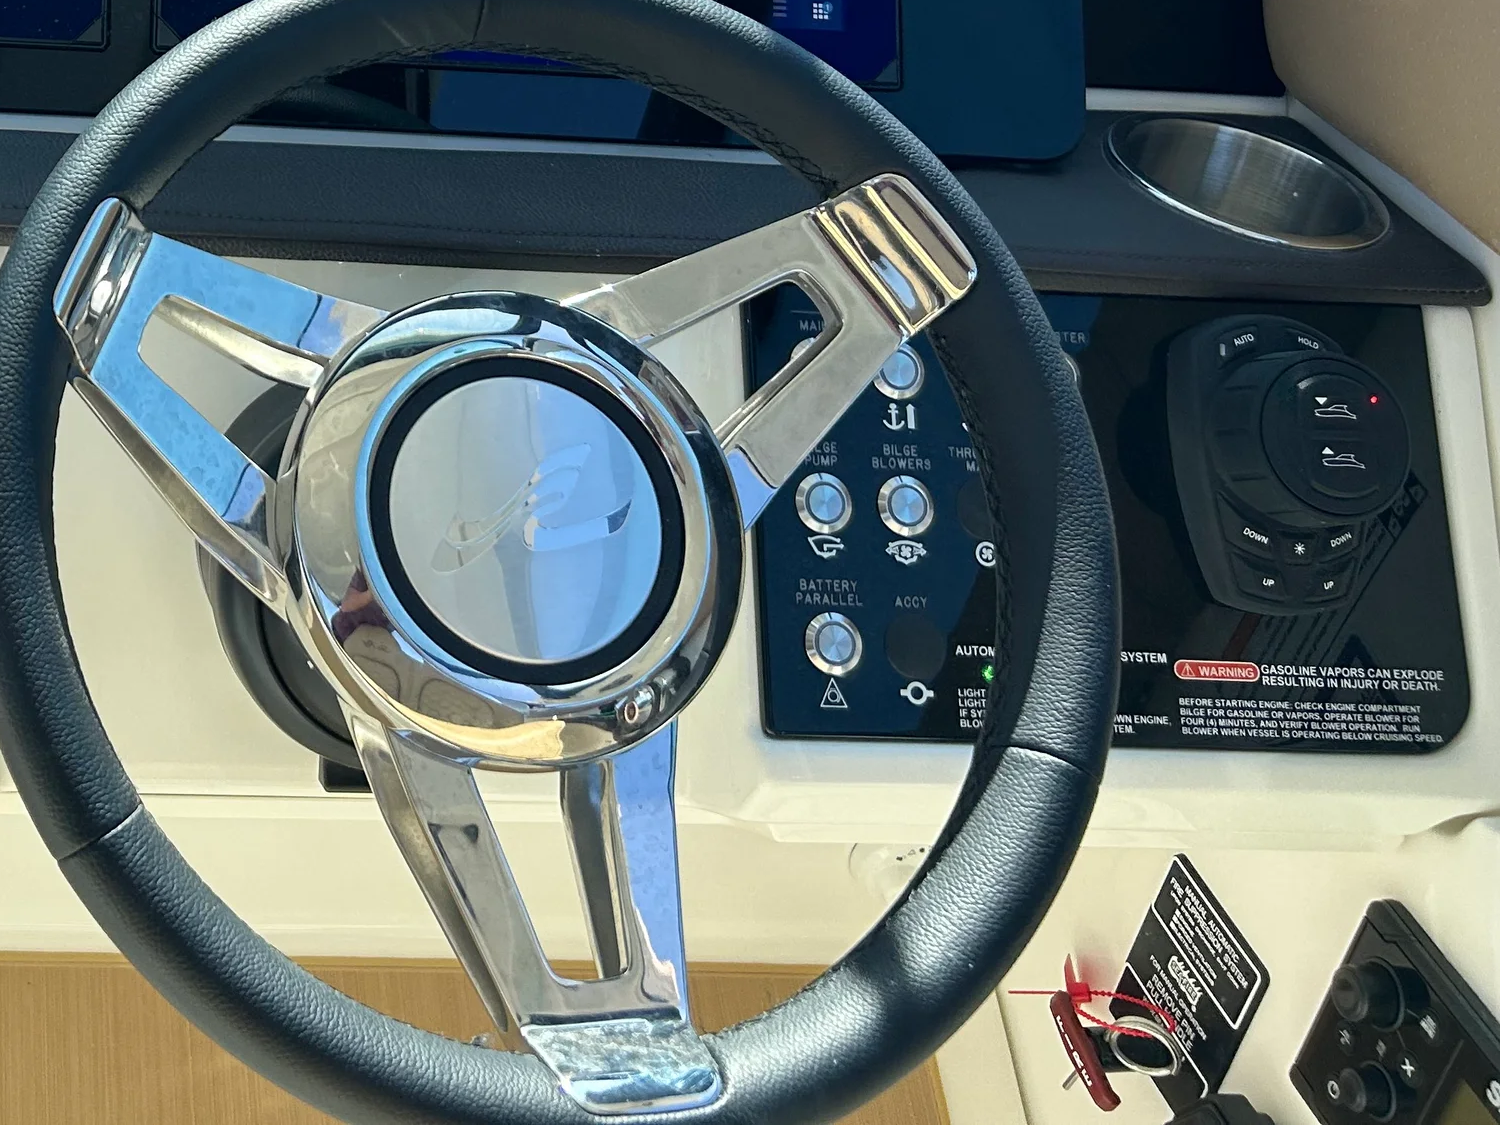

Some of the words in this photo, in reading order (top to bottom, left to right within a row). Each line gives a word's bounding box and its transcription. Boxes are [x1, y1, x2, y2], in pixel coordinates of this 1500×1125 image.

[1233, 333, 1255, 347] AUTO
[1297, 336, 1320, 350] HOLD
[883, 444, 918, 457] BILGE
[804, 454, 838, 467] PUMP
[872, 457, 931, 470] BLOWERS
[1242, 526, 1269, 545] DOWN
[1330, 531, 1352, 548] DOWN
[800, 579, 857, 593] BATTERY
[1262, 578, 1275, 588] UP
[1323, 580, 1334, 590] UP
[796, 592, 863, 607] PARALLEL
[895, 596, 927, 609] ACCY
[1120, 651, 1167, 664] SYSTEM
[1198, 665, 1255, 678] WARNING
[1260, 664, 1316, 676] GASOLINE
[1319, 666, 1365, 678] VAPORS
[1367, 668, 1391, 679] CAN
[1393, 669, 1444, 681] EXPLODE
[1262, 676, 1324, 688] RESULTING
[1327, 678, 1338, 688] IN
[1340, 679, 1380, 689] INJURY
[1382, 680, 1399, 690] OR
[1401, 681, 1441, 691] DEATH.
[958, 688, 986, 697] LIGHT
[958, 698, 986, 708] LIGHT
[1179, 697, 1213, 707] BEFORE
[1215, 699, 1257, 708] STARTING
[1294, 702, 1324, 711] CHECK
[1326, 703, 1356, 711] ENGINE
[1358, 703, 1421, 713] COMPARTMENT
[1180, 708, 1205, 716] BILGE
[1207, 709, 1225, 717] FOR
[1226, 710, 1269, 719] GASOLINE
[1324, 713, 1364, 722] OPERATE
[1365, 714, 1400, 723] BLOWER
[1402, 715, 1420, 723] FOR
[1181, 717, 1205, 726] FOUR
[1260, 720, 1278, 728] AND
[1279, 721, 1309, 730] VERIFY
[1311, 722, 1347, 730] BLOWER
[1182, 727, 1219, 735] BLOWER
[1220, 728, 1246, 736] WHEN
[1247, 729, 1280, 738] VESSEL
[1292, 730, 1340, 739] OPERATING
[1342, 732, 1372, 740] BELOW
[1374, 733, 1413, 741] CRUISING
[1151, 974, 1182, 1021] REMOVE
[1181, 1019, 1195, 1040] PIN
[1056, 1015, 1092, 1086] FIRE
